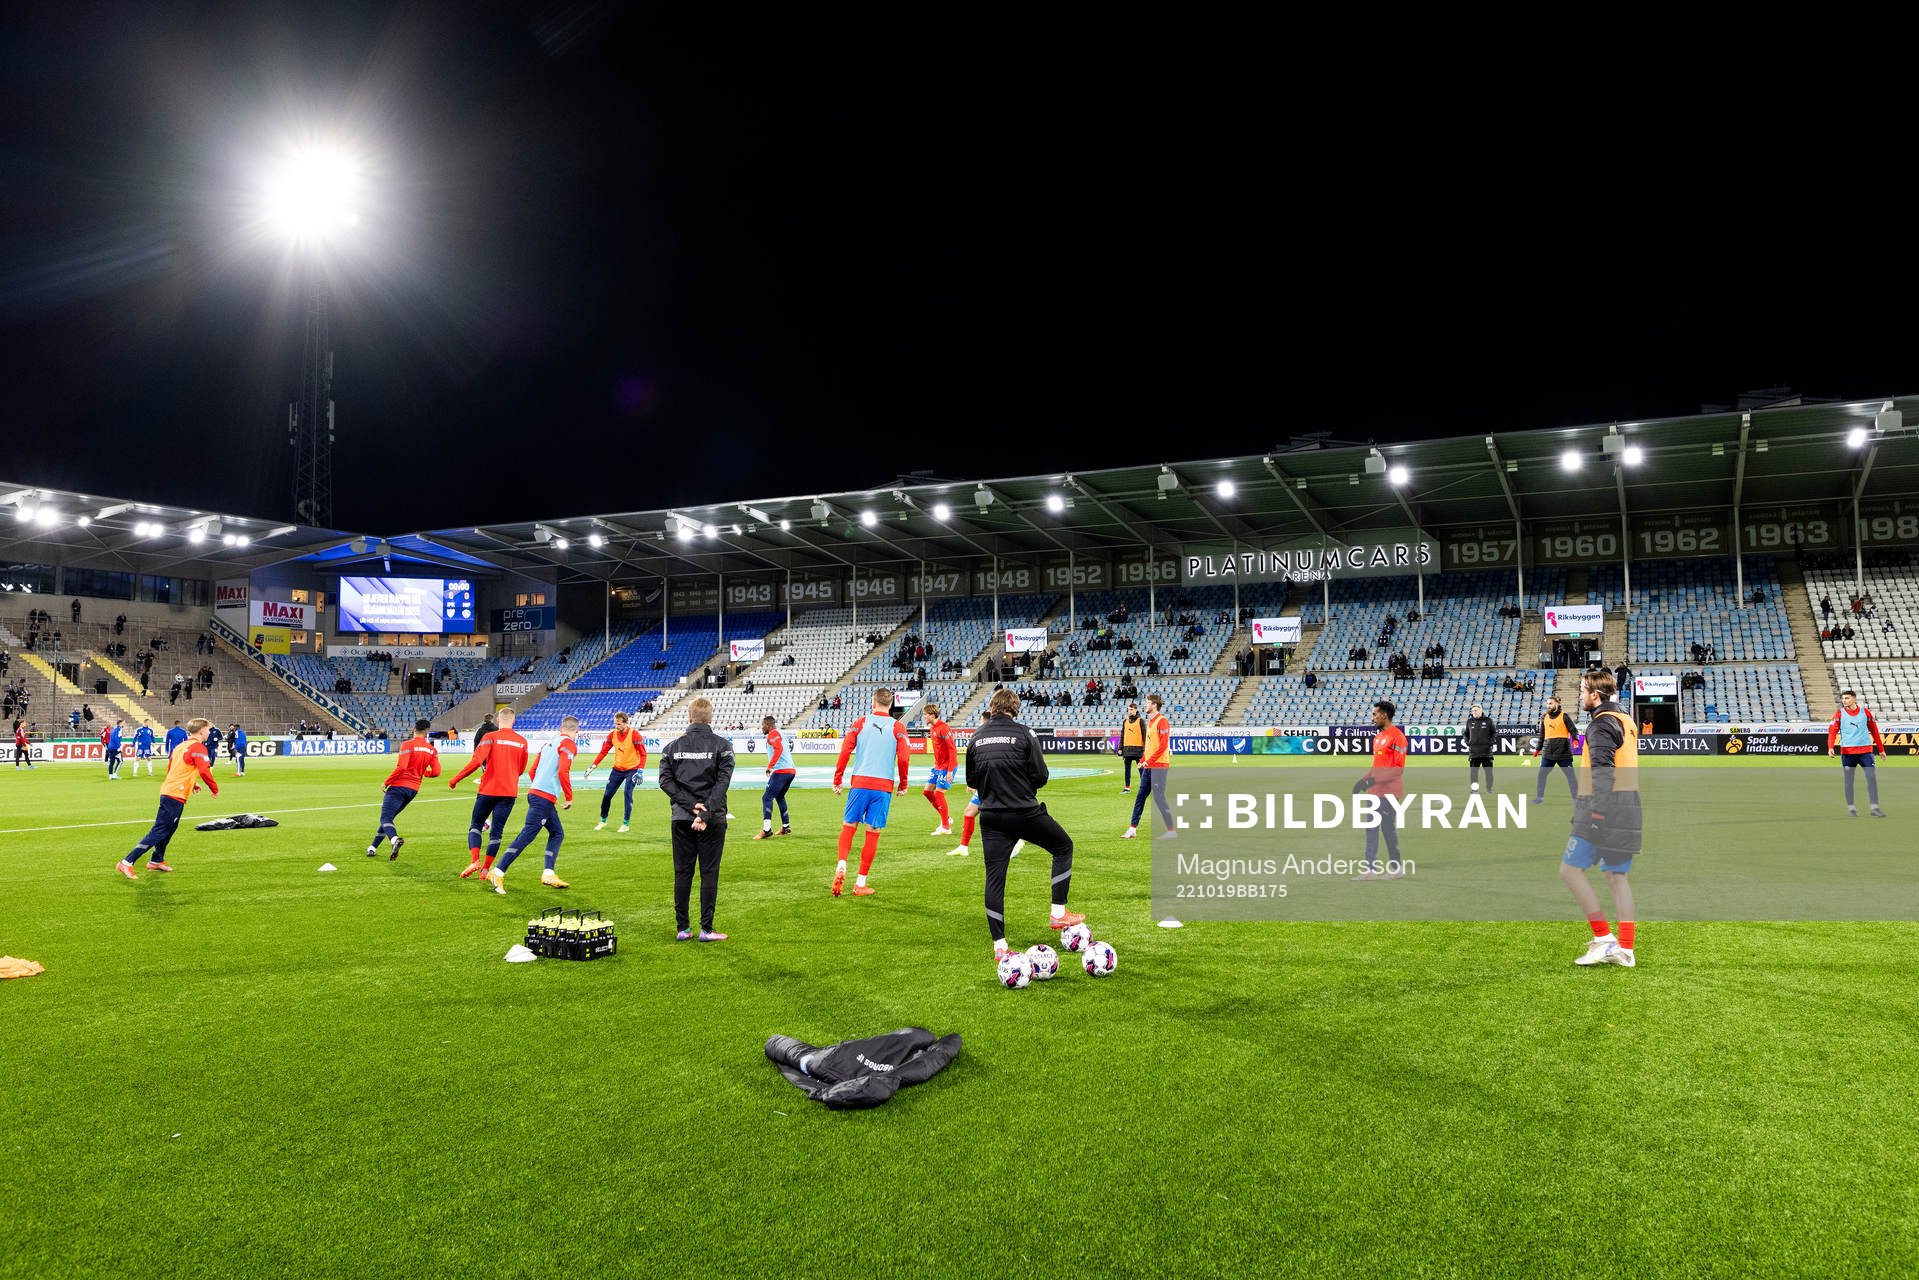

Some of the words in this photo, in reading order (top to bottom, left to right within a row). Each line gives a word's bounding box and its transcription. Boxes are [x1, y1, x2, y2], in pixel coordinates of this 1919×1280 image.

[1744, 520, 1829, 547] 1963
[1859, 515, 1919, 541] 198
[1540, 534, 1617, 559] 1960
[1640, 528, 1720, 553] 1962
[1188, 542, 1431, 578] PLATINUMCARS
[1449, 539, 1517, 564] 1957
[977, 569, 1030, 590] 1948
[1046, 565, 1102, 587] 1952
[1118, 560, 1177, 582] 1956
[1281, 570, 1332, 582] ARENA
[782, 580, 833, 600] 1945
[848, 577, 896, 597] 1946
[911, 573, 960, 594] 1947
[216, 586, 247, 601] MAXI
[727, 585, 771, 603] 1943
[263, 601, 304, 619] MAXI
[503, 609, 525, 621] pre
[1557, 613, 1601, 622] Riksbyggen
[503, 620, 532, 631] zero
[208, 619, 268, 668] CURVA
[290, 740, 385, 754] MALMBERGS
[800, 741, 836, 751] Vallacom
[1042, 740, 1116, 750] IUMDESIGN
[1637, 738, 1710, 750] EVENTIA
[1746, 735, 1771, 745] Spol
[1771, 736, 1778, 744] &
[1746, 744, 1819, 753] Industriservice
[54, 743, 136, 759] CRAO
